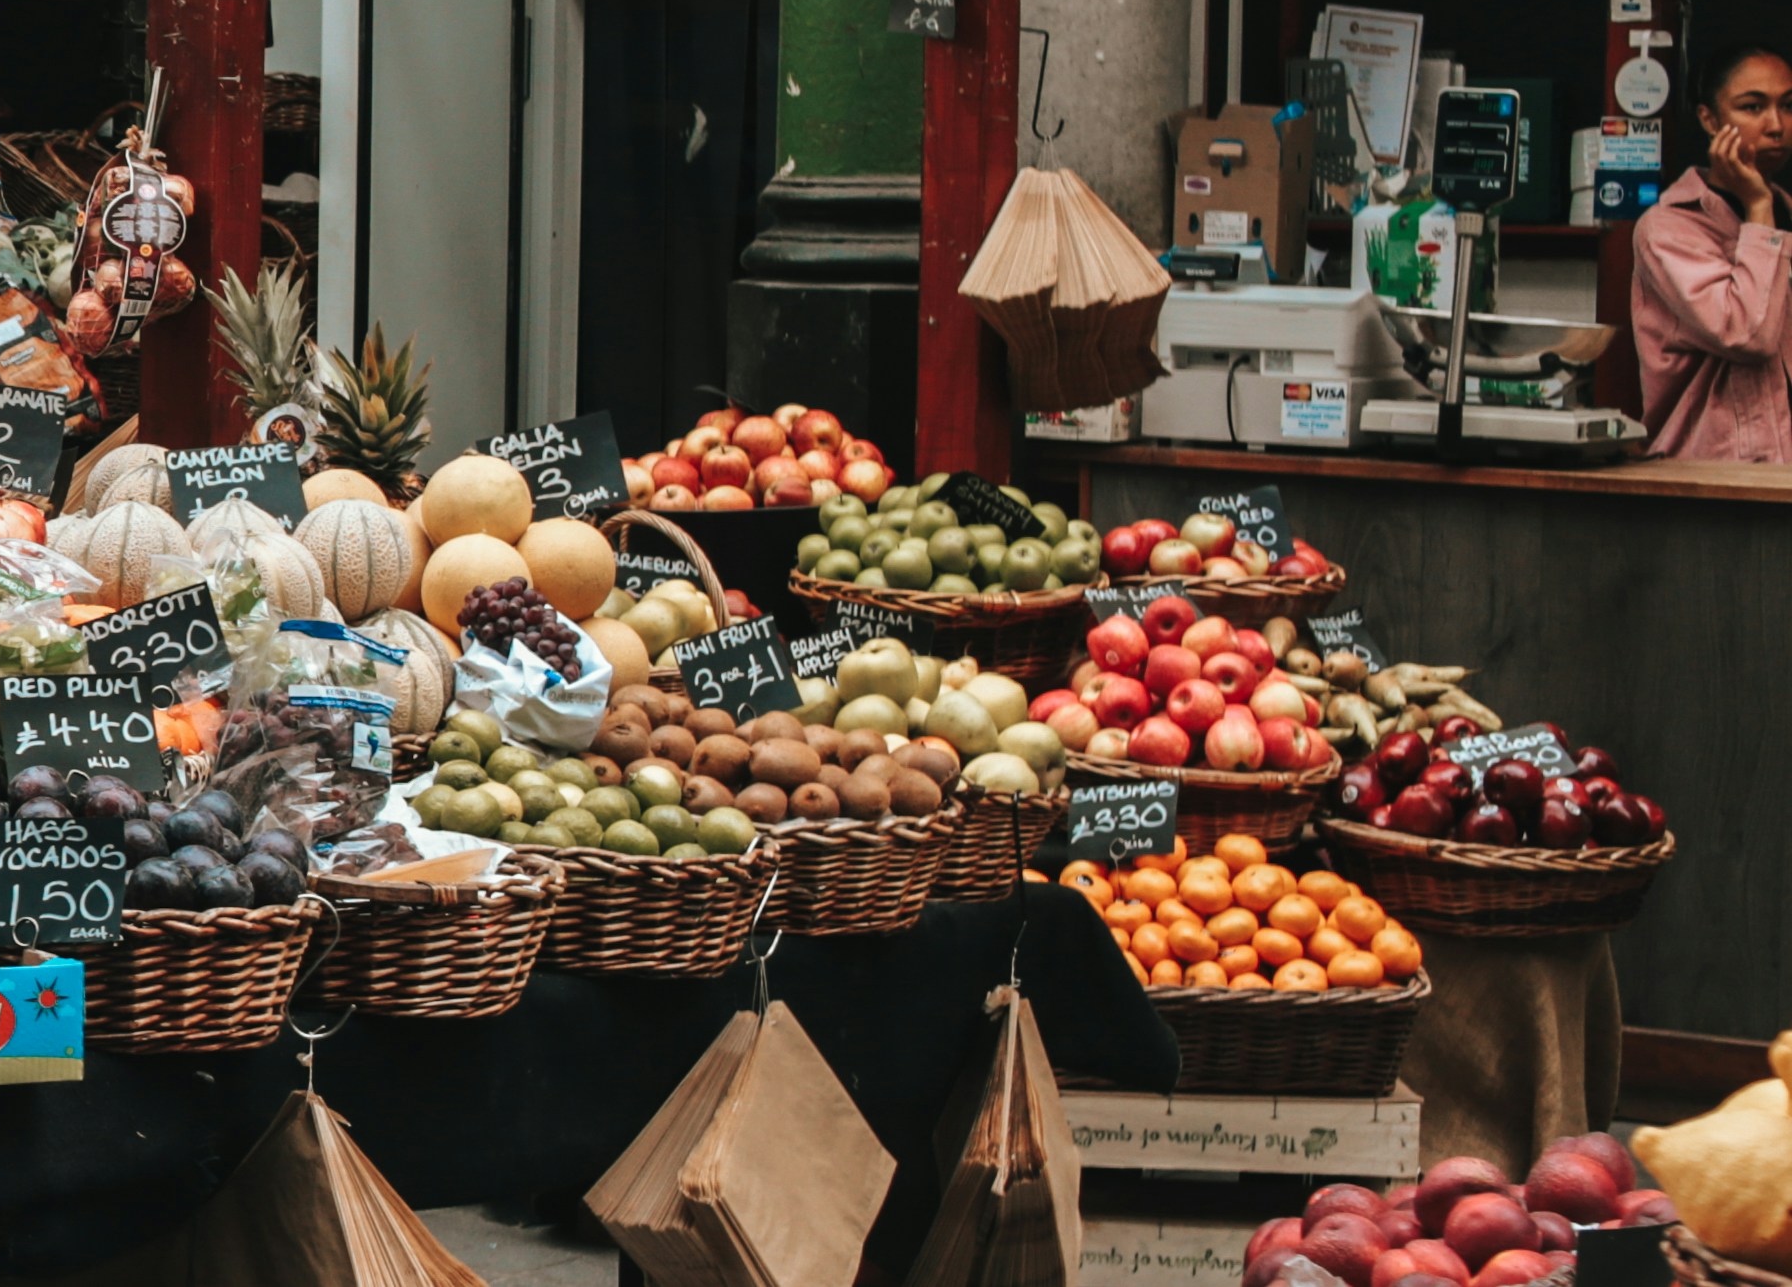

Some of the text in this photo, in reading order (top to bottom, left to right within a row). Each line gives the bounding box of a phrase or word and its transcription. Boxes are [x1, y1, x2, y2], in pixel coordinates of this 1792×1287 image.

[1632, 123, 1660, 134] VISA
[1518, 145, 1529, 183] FIRST
[1315, 387, 1346, 400] VISA
[489, 423, 564, 459] GALIA
[166, 443, 293, 471] CANTALOUPE
[509, 439, 583, 472] ELON
[184, 462, 265, 489] MELON
[1239, 506, 1274, 525] RED
[836, 601, 914, 633] WILLIAM
[676, 616, 775, 664] KIWI FRUIT
[789, 626, 856, 660] BRAMLEY
[694, 644, 785, 708] 3 FOR £1
[796, 649, 849, 677] APPLES
[3, 675, 140, 703] RED PLUM
[16, 709, 156, 755] £4.40
[1459, 735, 1506, 751] RED
[1071, 780, 1176, 804] SATSUMAS
[4, 819, 89, 843] HASS
[1071, 802, 1167, 847] £3.30
[1141, 1123, 1298, 1155] The Kingdom of
[1132, 1252, 1151, 1274] of
